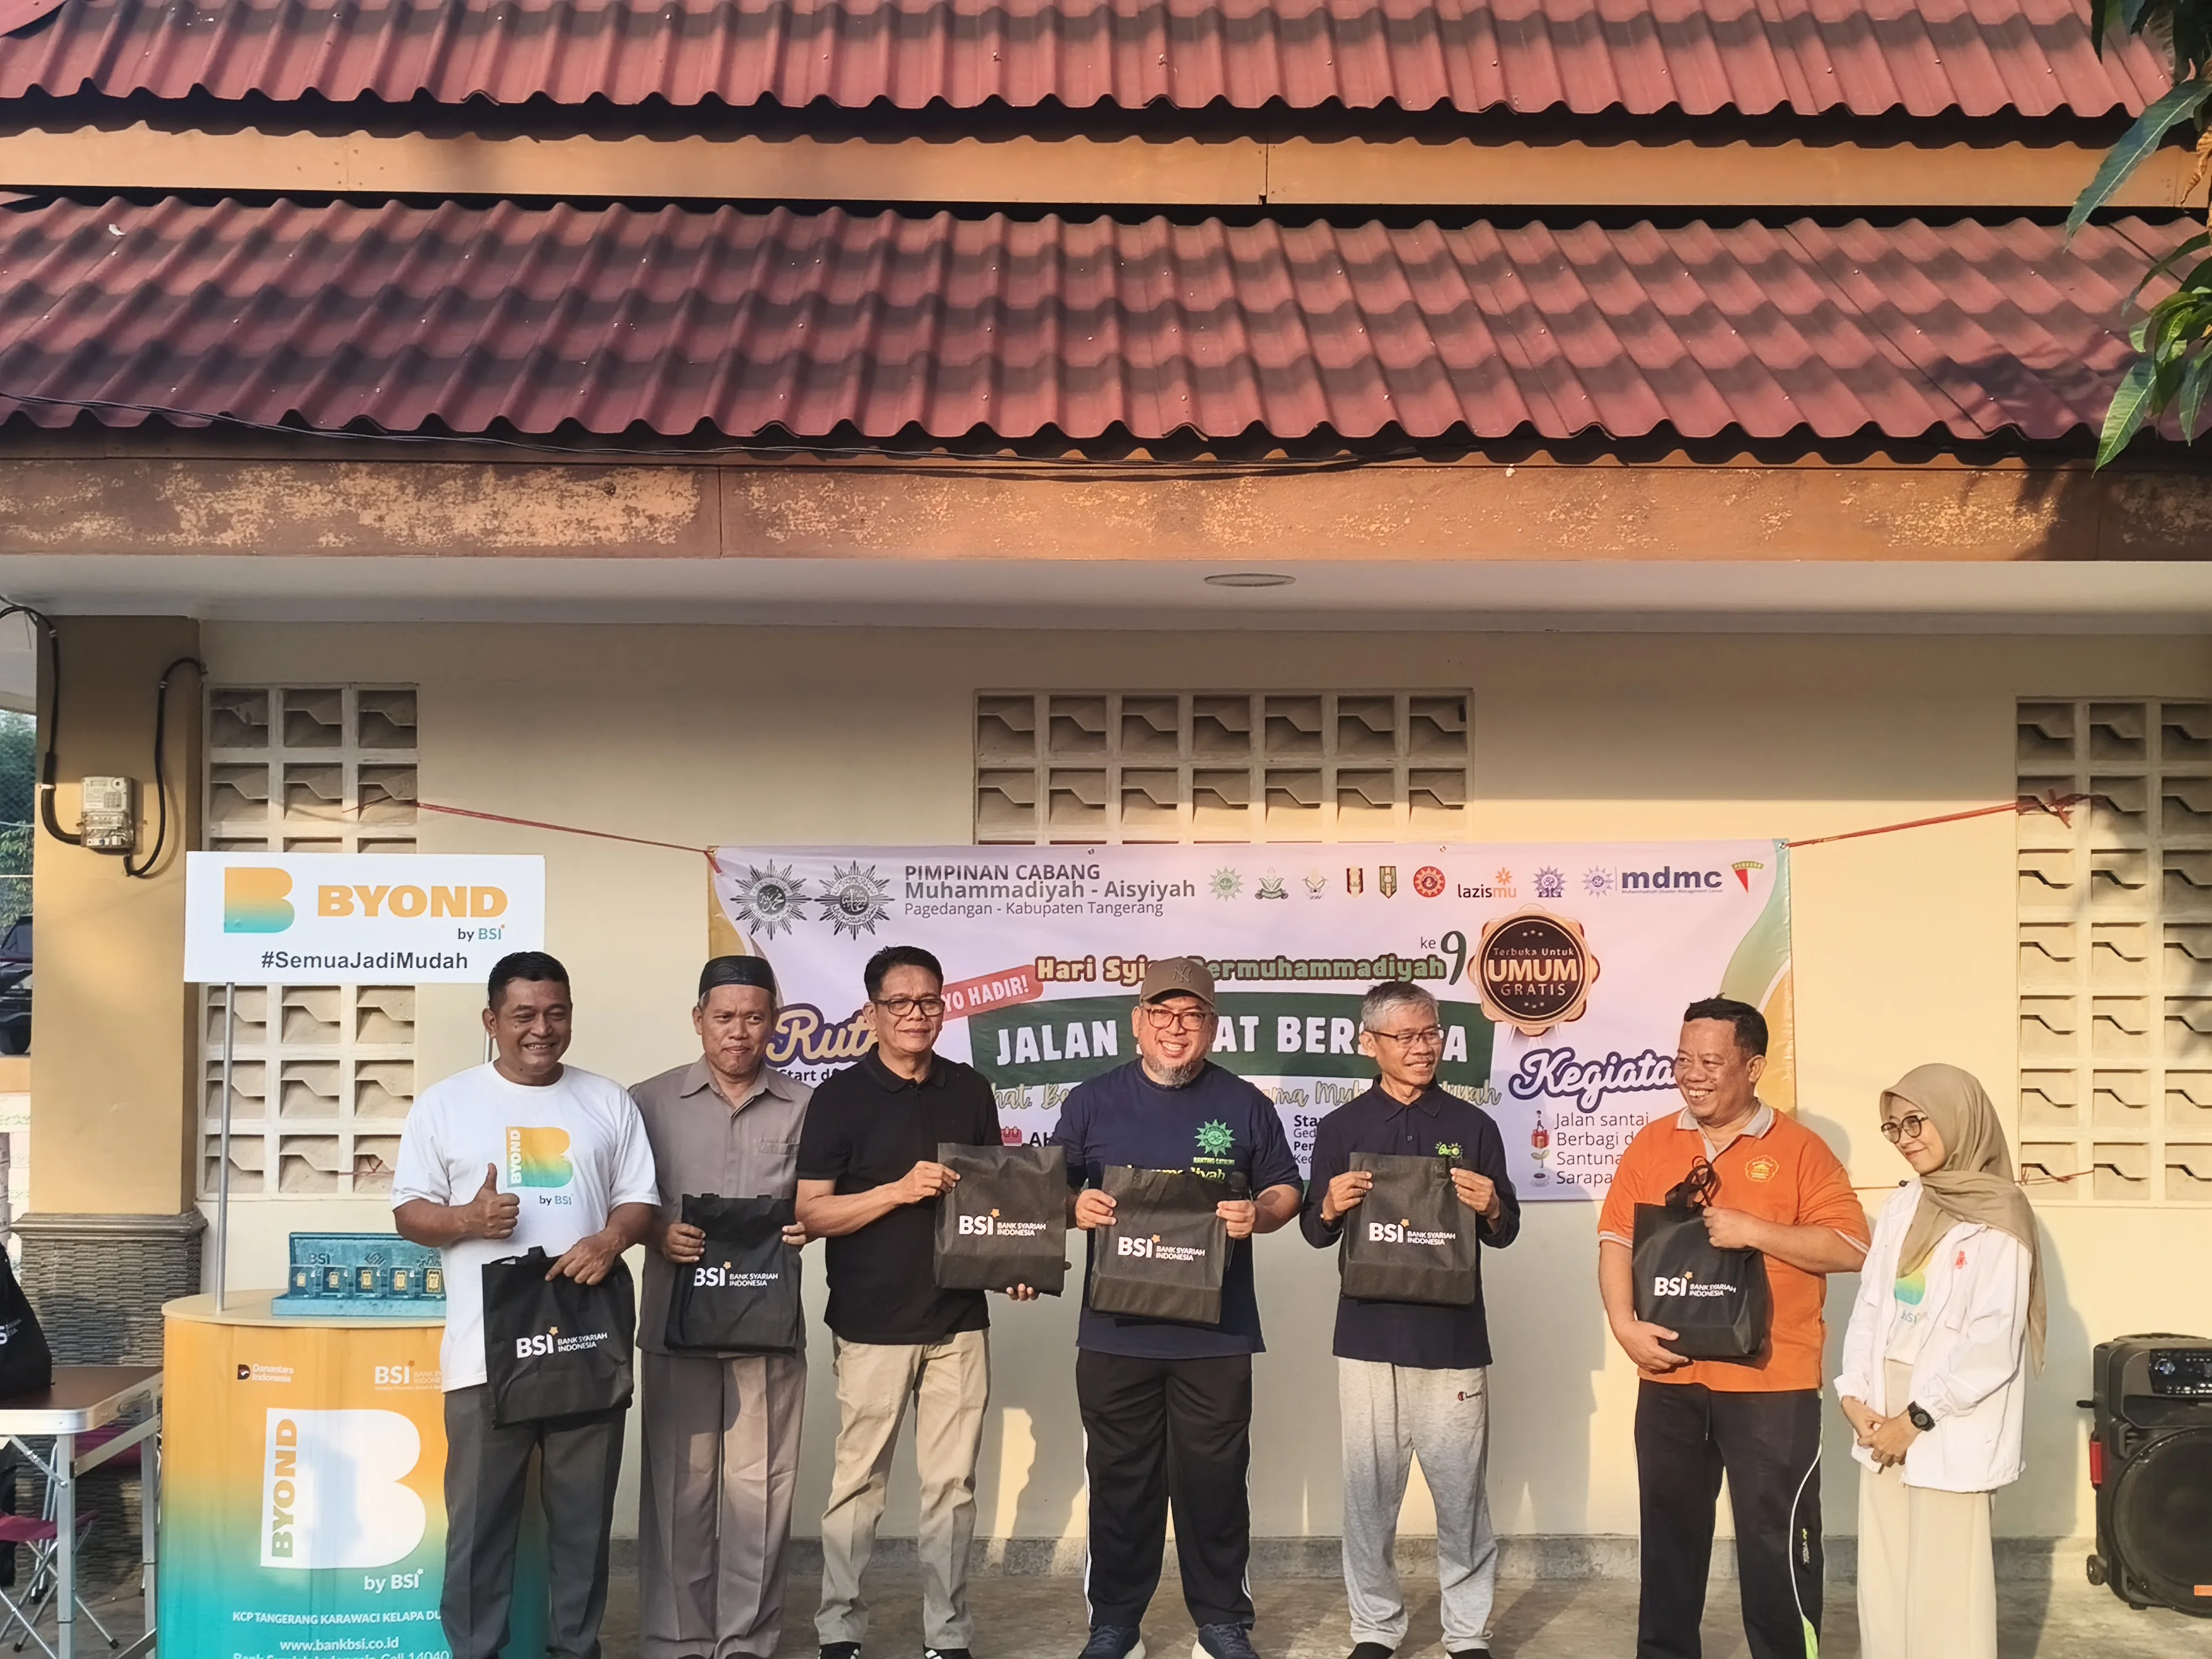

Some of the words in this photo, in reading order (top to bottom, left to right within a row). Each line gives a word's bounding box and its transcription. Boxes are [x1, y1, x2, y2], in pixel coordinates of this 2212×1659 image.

[905, 865, 1009, 880] PIMPINAN
[1016, 864, 1100, 880] CABANG
[1622, 866, 1722, 888] mdmc
[906, 881, 1084, 902] Muhammadiyah
[1104, 880, 1195, 902] Aisyiyah
[1458, 885, 1516, 898] lazismu
[318, 885, 508, 918] BYOND
[905, 902, 992, 918] Pagedangan
[1006, 902, 1083, 918] Kabupaten
[1088, 901, 1163, 917] Tangerang
[457, 928, 474, 941] by
[478, 927, 502, 940] BSI
[261, 951, 468, 969] #SemuaJadiMudah
[1421, 937, 1436, 949] ke
[1440, 930, 1467, 986] 9
[1493, 948, 1536, 956] Terbuka
[1542, 947, 1574, 956] Untuk
[1036, 956, 1095, 981] Hari
[1104, 955, 1148, 986] Syi
[1188, 954, 1446, 982] ermuhammadiyah
[1488, 959, 1577, 982] UMUM
[941, 992, 965, 1013] YO
[968, 974, 1029, 1006] HADIR!
[1501, 984, 1566, 996] GRATIS
[996, 1020, 1118, 1066] JALAN
[1277, 1016, 1468, 1062] BERA
[1510, 1048, 1676, 1112] Kegiata
[1554, 1112, 1594, 1130] Jalan
[1601, 1112, 1649, 1127] santai
[1293, 1128, 1316, 1138] Ged
[1557, 1132, 1619, 1149] Berbagi
[1625, 1131, 1634, 1145] d
[1294, 1141, 1314, 1151] Per
[510, 1129, 522, 1184] BYOND
[1557, 1151, 1622, 1165] Santuna
[1556, 1171, 1612, 1187] Sarapa
[539, 1196, 552, 1205] by
[555, 1196, 571, 1205] BSI
[959, 1215, 994, 1235] BSI
[1017, 1222, 1046, 1230] SYARIAH
[1369, 1222, 1404, 1243] BSI
[1118, 1237, 1153, 1258] BSI
[1156, 1245, 1176, 1253] BANK
[1176, 1246, 1205, 1256] SYARIAH
[1407, 1237, 1445, 1245] INDONESIA
[310, 1253, 330, 1265] BSI
[1156, 1252, 1194, 1262] INDONESIA
[693, 1267, 725, 1286] BSI
[1654, 1277, 1687, 1296] BSI
[1709, 1284, 1737, 1293] SYARIAH
[516, 1334, 554, 1359] BSI
[557, 1336, 578, 1346] BANK
[578, 1332, 608, 1343] SYARIAH
[557, 1341, 597, 1353] INDONESIA
[252, 1373, 291, 1382] Indonesia
[253, 1364, 294, 1374] Danantara
[375, 1365, 409, 1384] BSI
[271, 1419, 297, 1558] BYOND
[364, 1575, 386, 1594] by
[391, 1574, 419, 1589] BSI
[233, 1611, 253, 1622] KCP
[254, 1613, 319, 1625] TANGERANG
[320, 1613, 380, 1624] KARAWACI
[382, 1611, 424, 1622] KELAPA
[426, 1610, 441, 1621] DU
[280, 1636, 399, 1651] www.bankbsi.co.id
